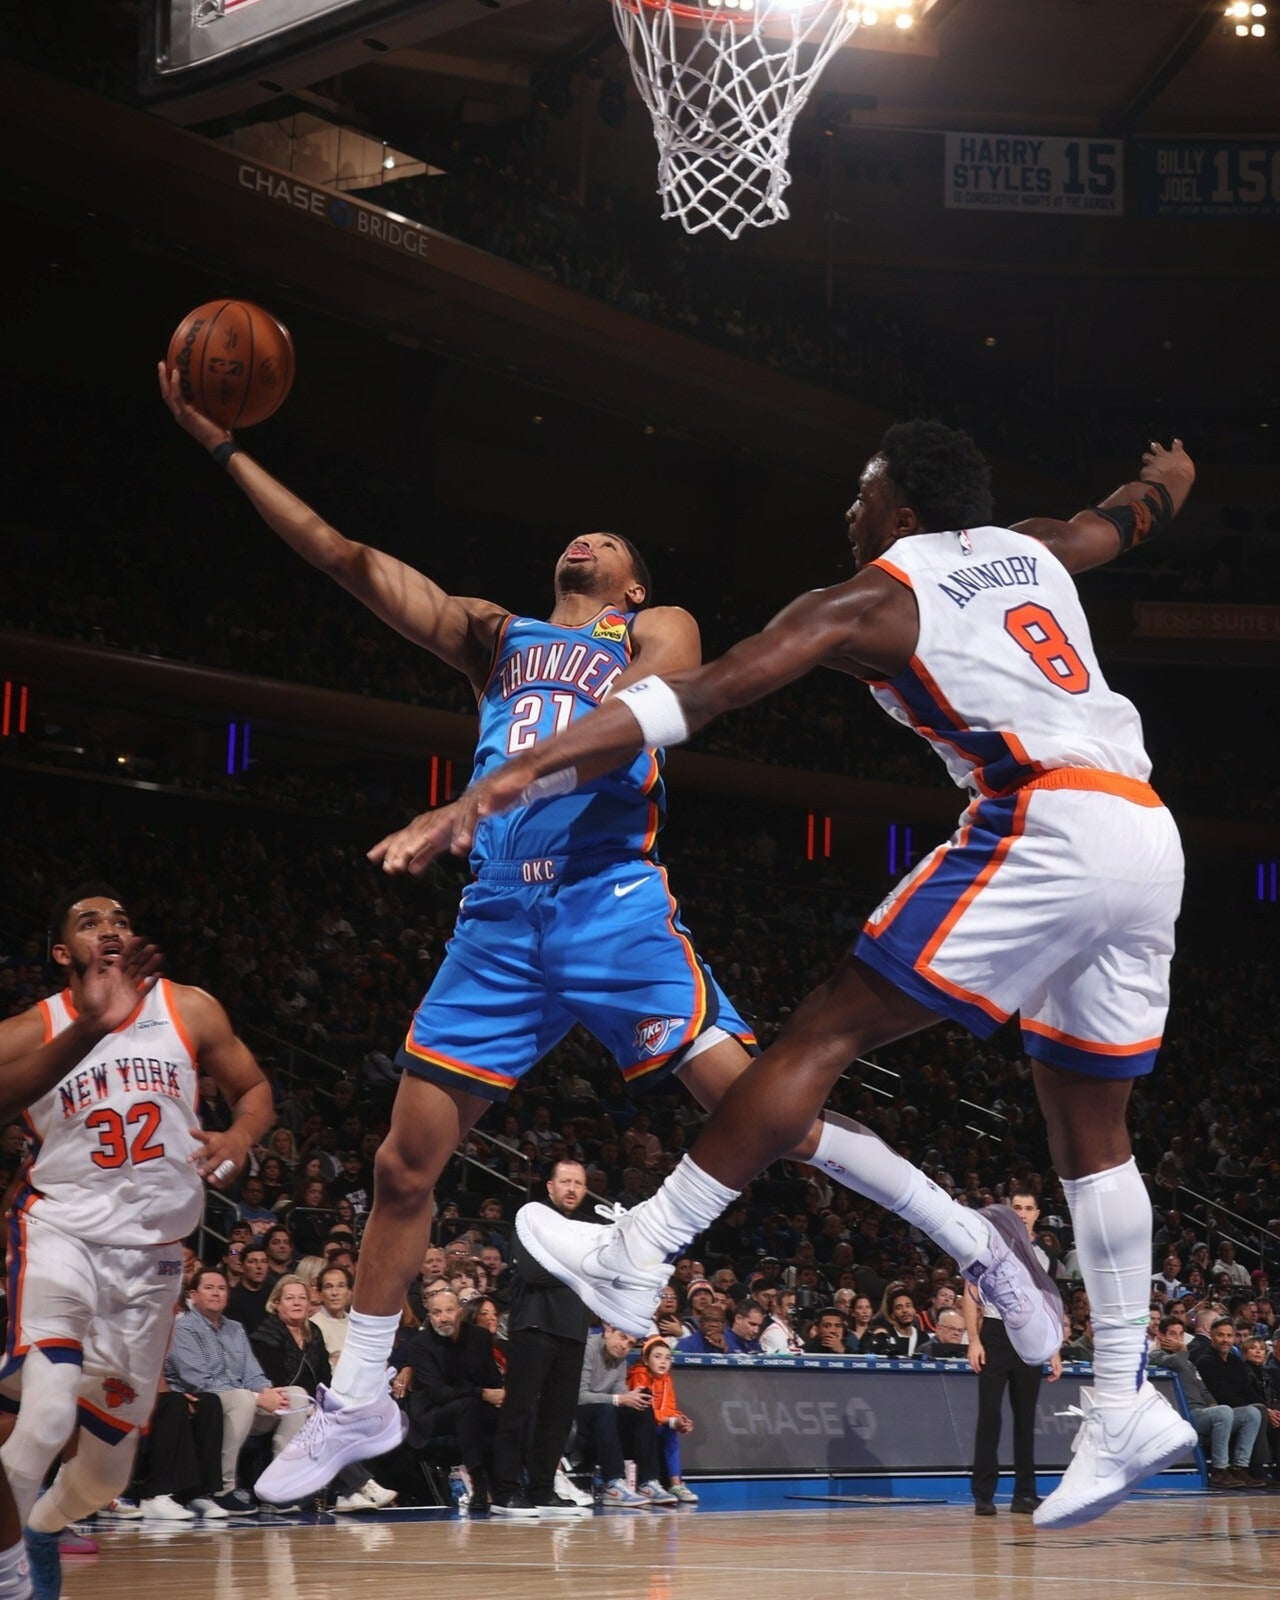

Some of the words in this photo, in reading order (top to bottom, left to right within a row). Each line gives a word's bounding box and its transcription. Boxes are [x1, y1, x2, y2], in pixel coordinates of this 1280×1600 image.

[953, 164, 1051, 192] STYLES
[960, 138, 1044, 165] HARRY
[1063, 142, 1116, 195] 15
[1157, 149, 1206, 175] BILLY
[238, 165, 326, 217] CHASE
[357, 211, 429, 257] BRIDGE
[1160, 177, 1202, 203] JOEL
[938, 555, 1039, 609] ANUNOBY
[1004, 601, 1090, 694] 8
[508, 692, 577, 755] 21
[522, 860, 555, 882] OKC
[58, 1063, 109, 1119] NEW
[115, 1057, 181, 1098] YORK
[85, 1101, 165, 1169] 32
[721, 1401, 845, 1436] CHASE
